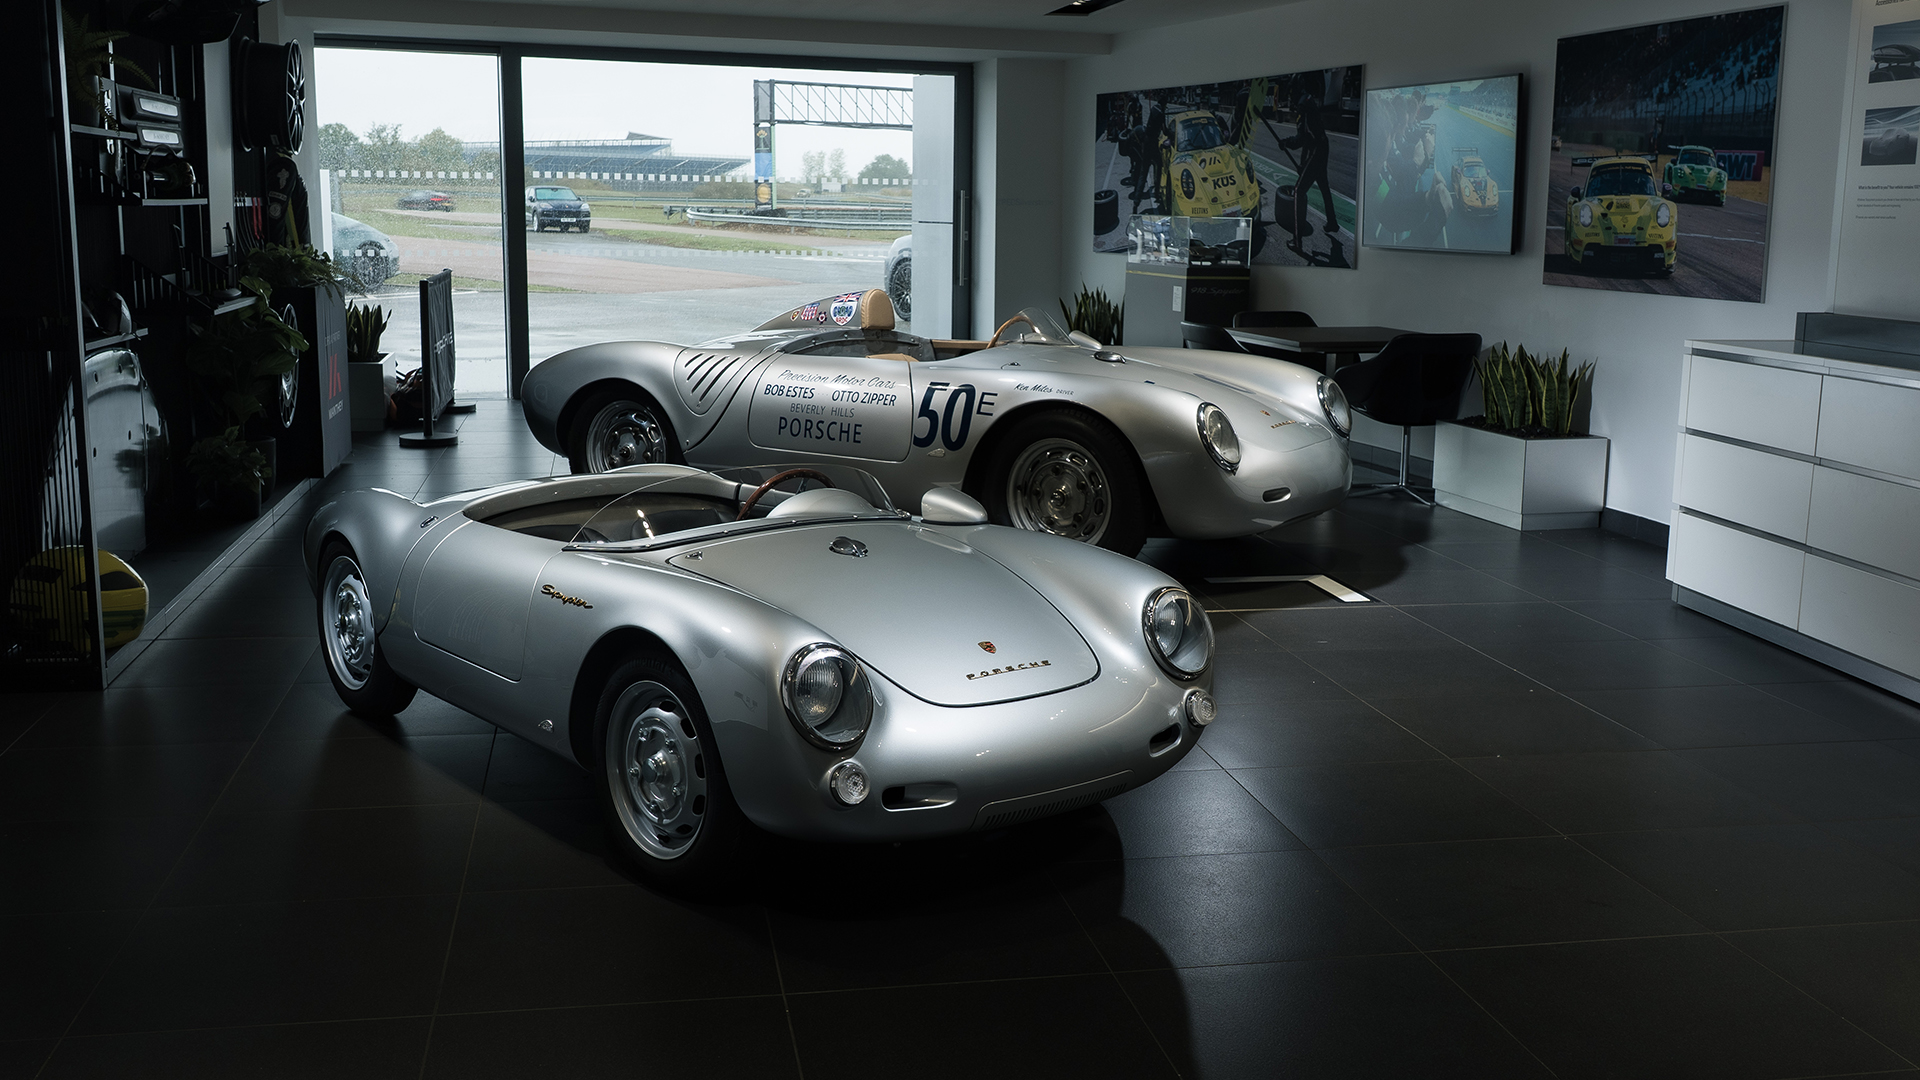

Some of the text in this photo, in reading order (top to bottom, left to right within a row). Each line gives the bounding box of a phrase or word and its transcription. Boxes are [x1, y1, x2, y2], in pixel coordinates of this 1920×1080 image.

[1212, 175, 1236, 190] KÜS
[1207, 287, 1245, 296] Spyder
[778, 369, 896, 389] Precision Motor Cars
[1013, 382, 1074, 396] Ken Miles DRIVER
[764, 383, 897, 407] BOB ESTES OTTO ZIPPER
[790, 402, 855, 418] BEVERLY HILLS
[778, 416, 863, 444] PORSCHE
[540, 584, 594, 609] Spyder
[965, 659, 1052, 681] PORSCHE
